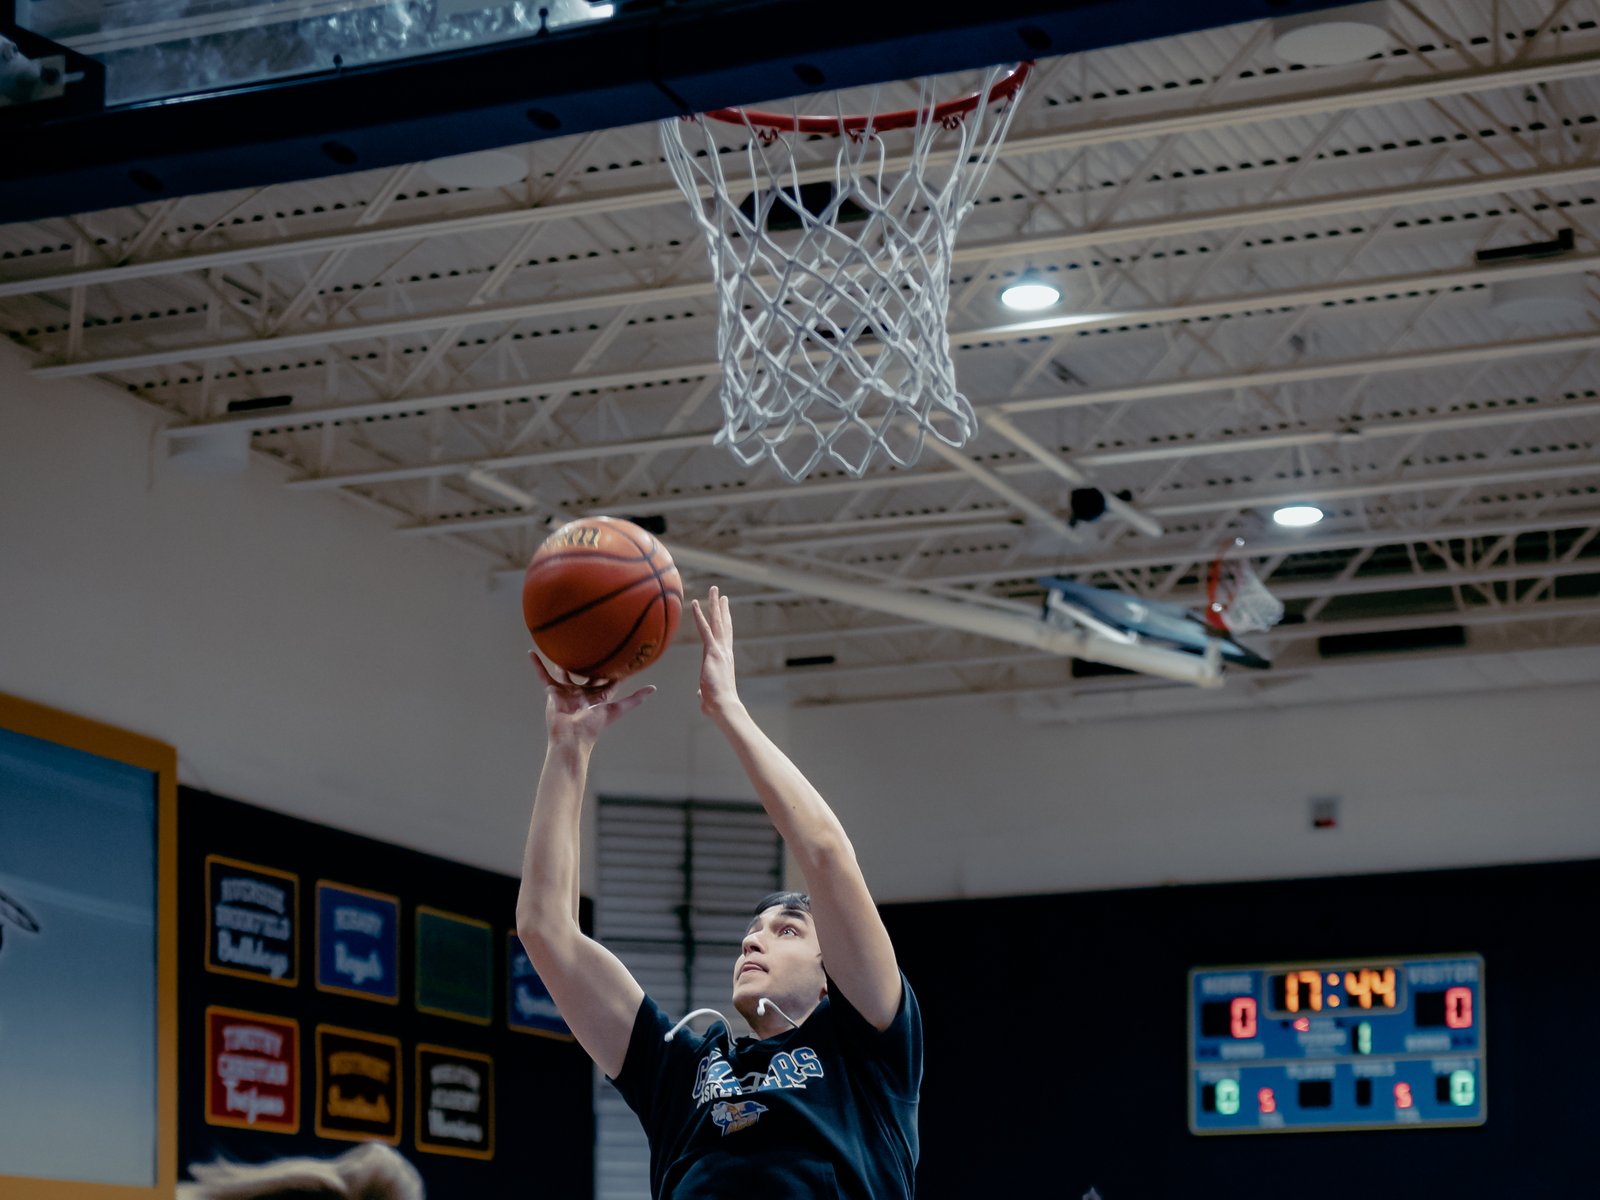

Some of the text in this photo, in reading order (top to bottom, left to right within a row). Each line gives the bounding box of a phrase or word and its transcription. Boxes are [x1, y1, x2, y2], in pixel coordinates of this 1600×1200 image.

[1286, 967, 1396, 1012] 17:44
[1445, 986, 1473, 1029] 0
[1230, 997, 1257, 1038] 0
